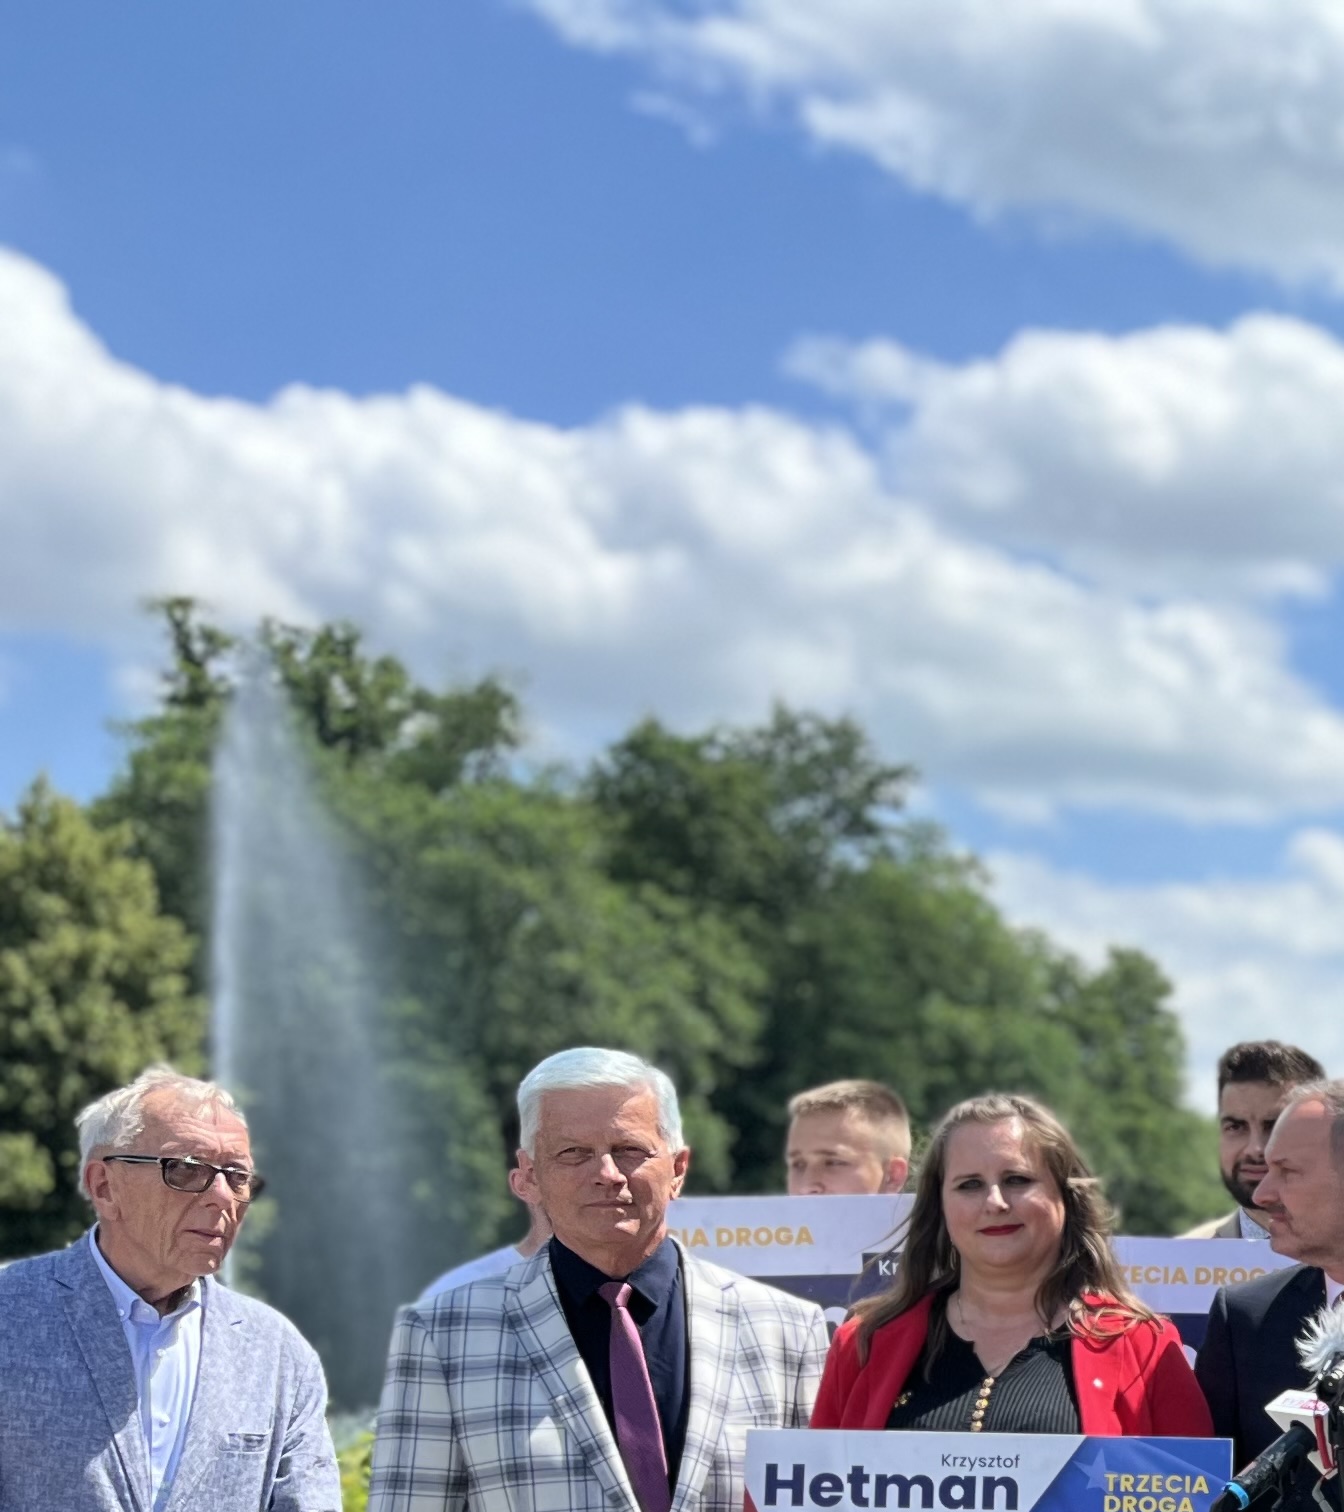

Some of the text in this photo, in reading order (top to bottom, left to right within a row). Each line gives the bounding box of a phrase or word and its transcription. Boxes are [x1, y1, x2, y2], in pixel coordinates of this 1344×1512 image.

[715, 1226, 814, 1248] DROGA
[1195, 1266, 1268, 1285] DROG
[941, 1453, 1021, 1471] Krzysztof
[764, 1463, 1019, 1511] Hetman
[1104, 1473, 1209, 1495] TRZECIA
